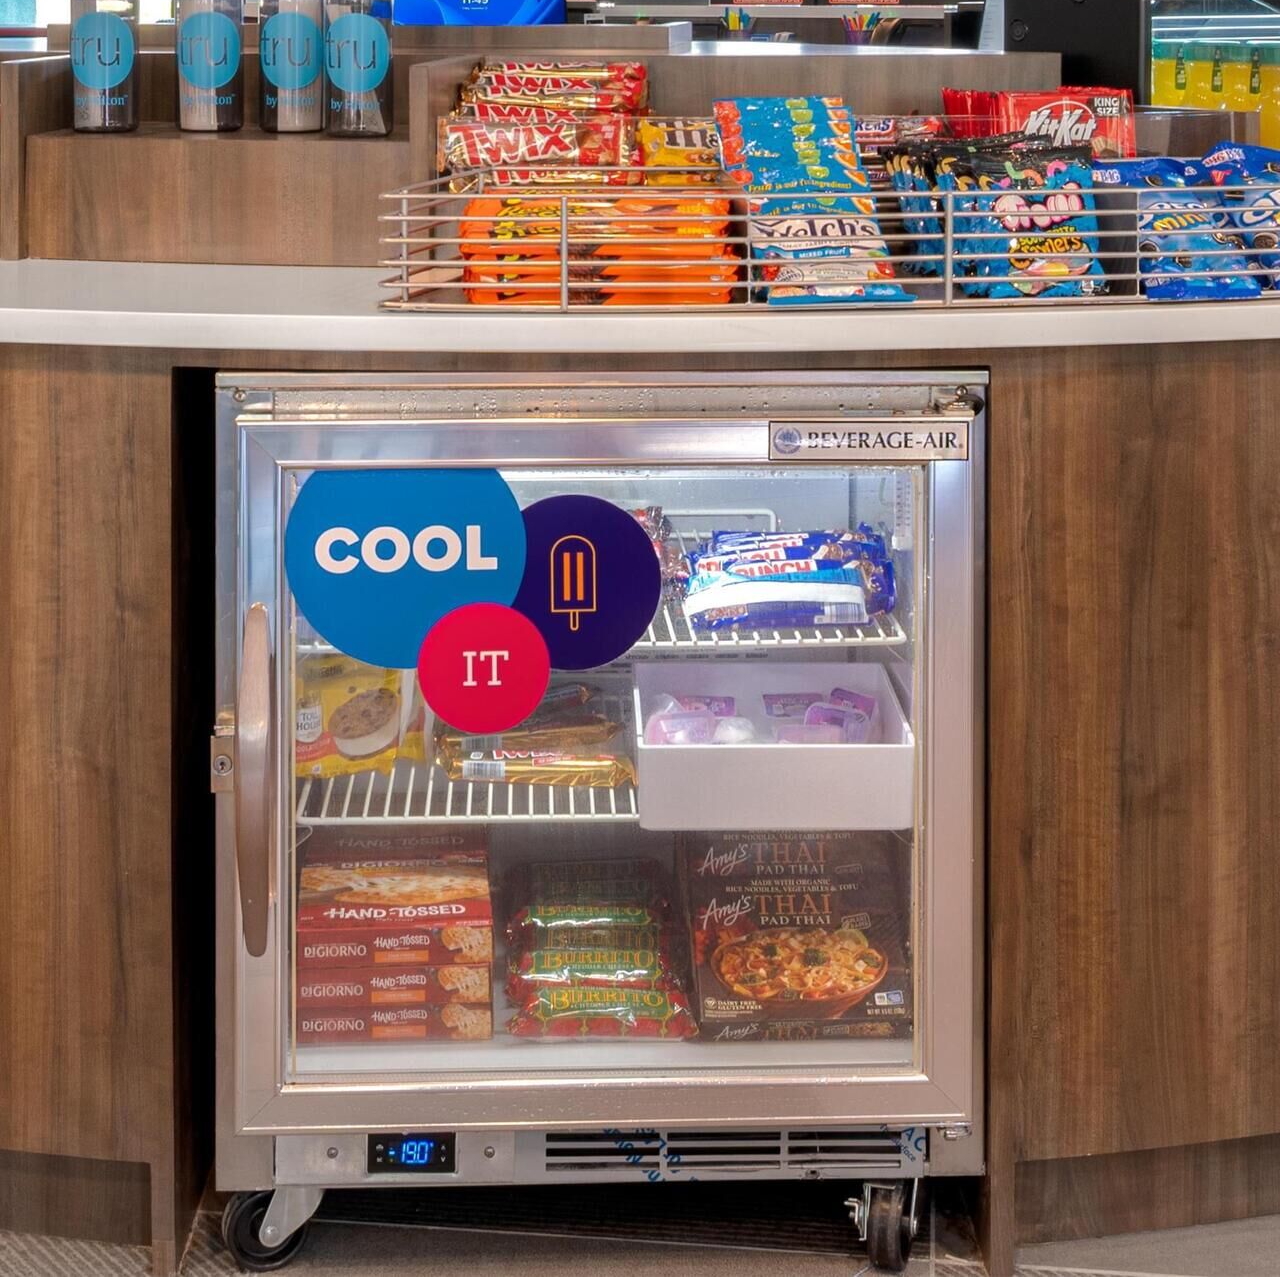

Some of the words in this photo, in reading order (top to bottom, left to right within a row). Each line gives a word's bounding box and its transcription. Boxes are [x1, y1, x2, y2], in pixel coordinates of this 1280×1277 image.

[70, 33, 120, 66] tru
[177, 33, 227, 66] tru
[261, 30, 310, 67] tru
[326, 32, 377, 70] tru
[266, 96, 278, 108] by
[330, 98, 343, 111] by
[1094, 97, 1119, 107] KING
[1097, 107, 1120, 116] SIZE
[448, 124, 576, 167] TWIX
[314, 525, 498, 574] COOL
[462, 650, 509, 687] IT
[698, 843, 749, 876] Amy's
[751, 842, 826, 864] THAI
[756, 865, 784, 874] PAD
[788, 864, 825, 874] THAI
[700, 895, 753, 930] Amy's
[755, 894, 832, 915] THAI
[760, 916, 789, 925] PAD
[794, 915, 831, 925] THAI
[304, 945, 367, 958] DIGIORNO
[543, 950, 654, 969] BURRITO
[301, 984, 364, 998] DIGIORNO
[551, 990, 663, 1010] BURRITO
[302, 1020, 365, 1032] DIGIORNO
[713, 1023, 760, 1039] Amy's
